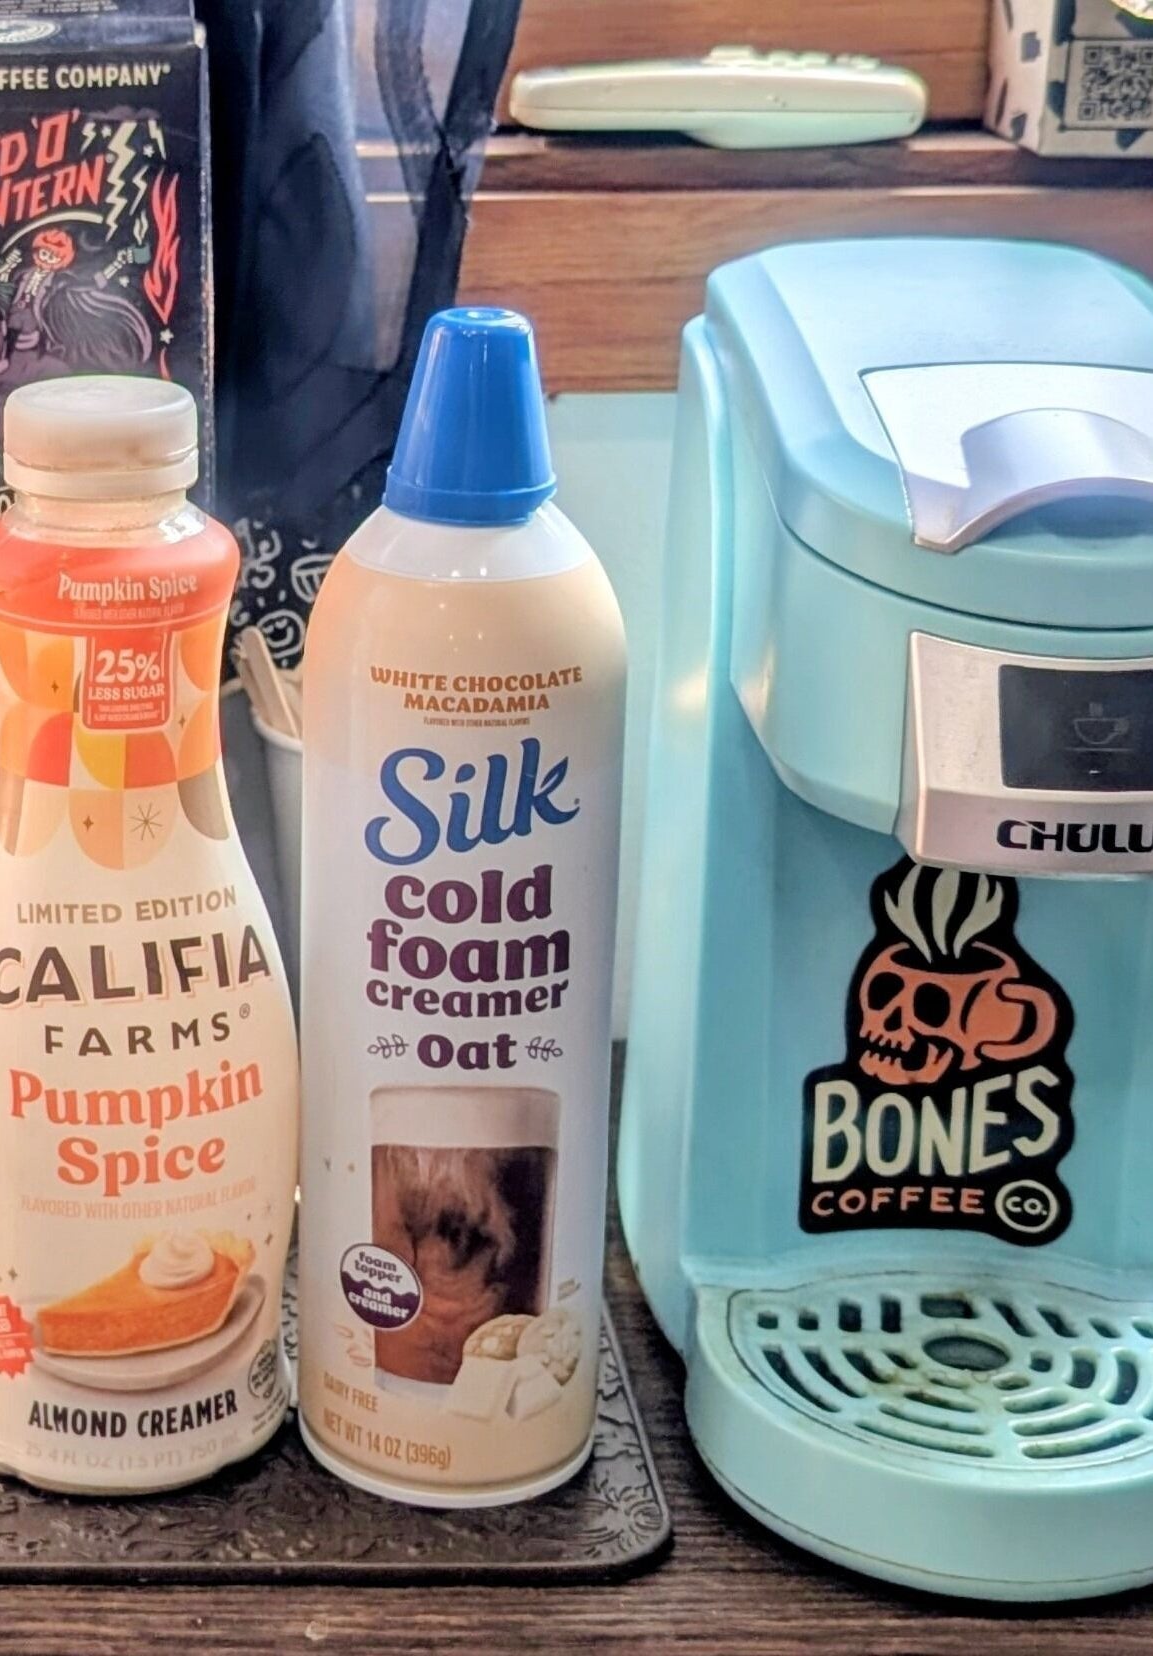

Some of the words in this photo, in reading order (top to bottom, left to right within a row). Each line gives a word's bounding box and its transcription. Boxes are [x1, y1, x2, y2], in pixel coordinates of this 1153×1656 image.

[56, 63, 163, 89] COMPANY
[58, 572, 145, 606] Pumpkin
[148, 573, 198, 603] Spice
[94, 648, 161, 683] 25%
[370, 665, 447, 692] WHITE
[451, 665, 583, 693] CHOCOLATE
[88, 686, 121, 701] LESS
[122, 683, 165, 700] SUGAR
[403, 692, 550, 714] MACADAMIA
[364, 737, 581, 866] Silk
[17, 902, 123, 925] LIMITED
[135, 885, 238, 922] EDITION
[384, 864, 553, 924] cold
[366, 918, 570, 983] foam
[366, 979, 569, 1018] creamer
[45, 1011, 232, 1057] FARMS
[9, 1059, 264, 1129] Pumpkin
[812, 1065, 1060, 1183] BONES
[57, 1134, 226, 1197] Spice
[84, 1201, 118, 1219] WITH
[122, 1200, 162, 1219] OTHER
[812, 1186, 985, 1215] COFFEE
[354, 1260, 403, 1283] topper
[359, 1251, 397, 1271] foam
[348, 1291, 410, 1318] creamer
[362, 1288, 392, 1304] and
[28, 1400, 127, 1438] ALMOND
[137, 1388, 238, 1438] CREAMER
[352, 1388, 378, 1413] FREE
[323, 1407, 342, 1436] NET
[345, 1421, 362, 1447] WT
[366, 1428, 380, 1453] 14
[384, 1435, 402, 1460] OZ
[406, 1440, 451, 1471] (396g)
